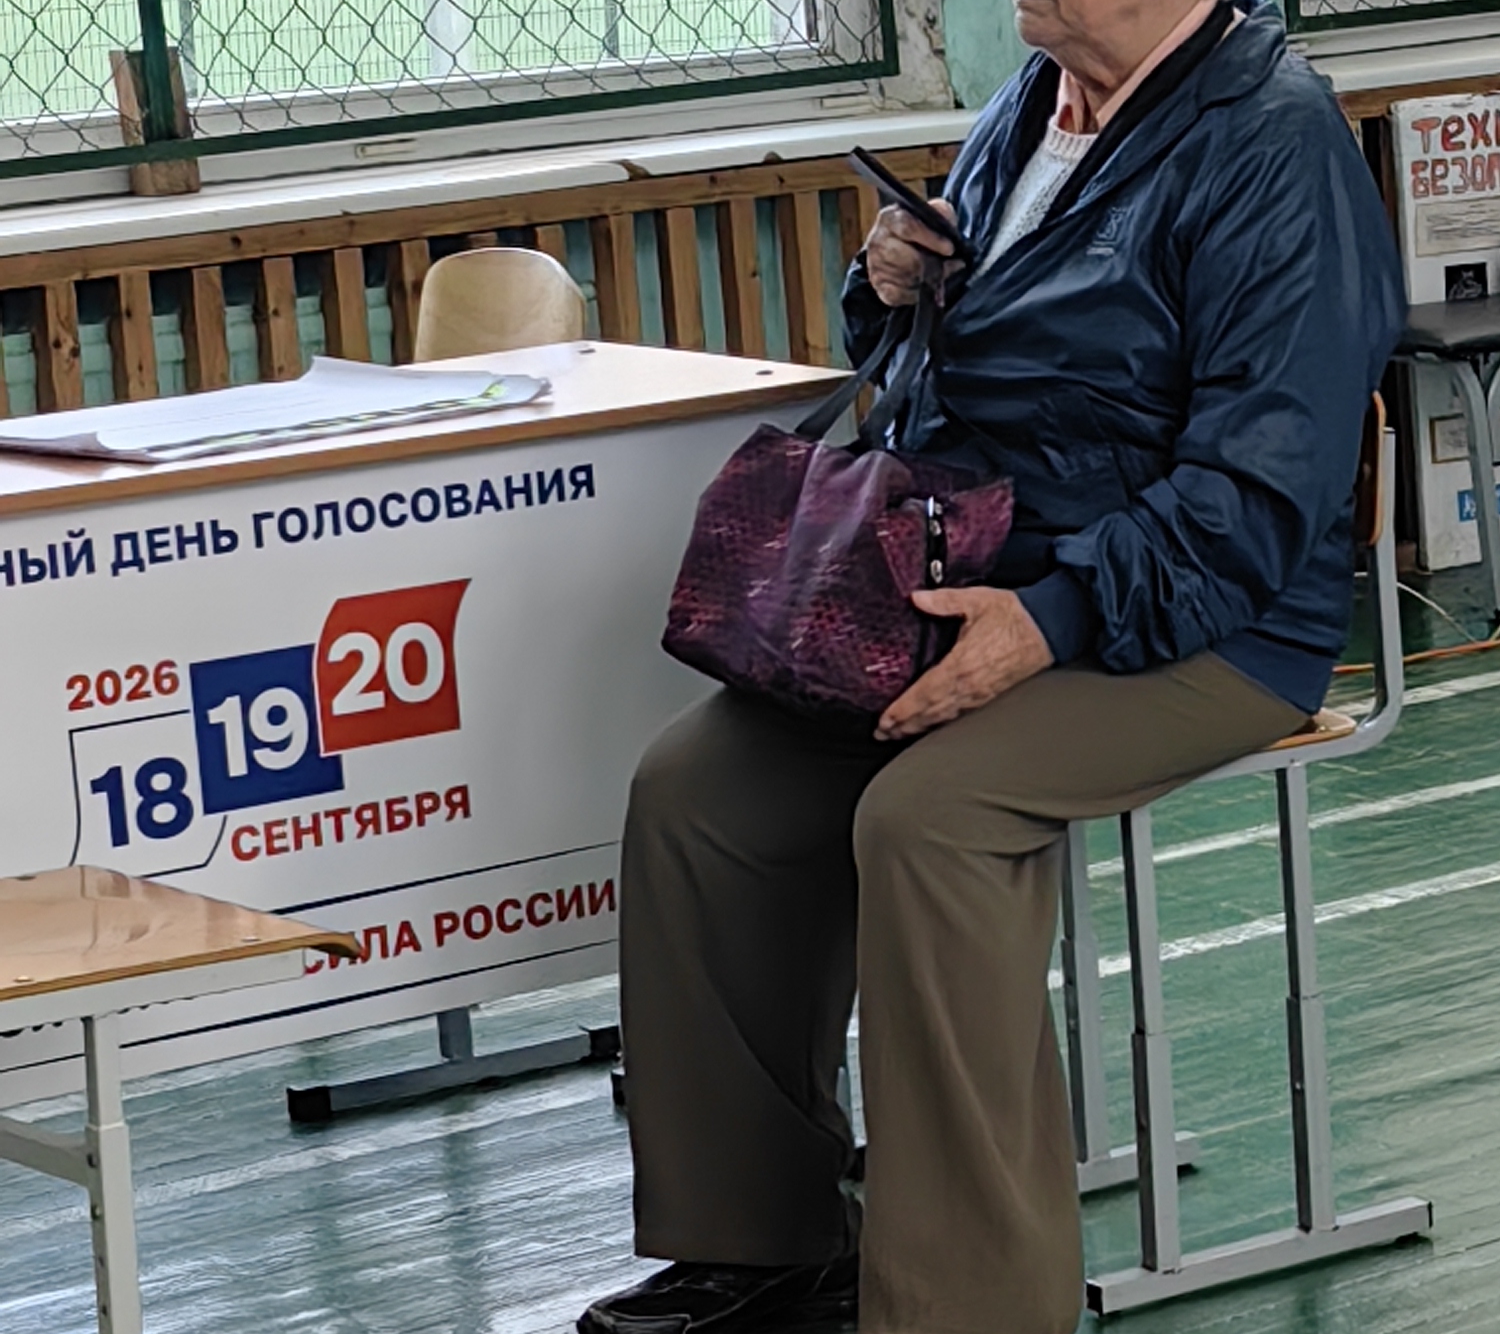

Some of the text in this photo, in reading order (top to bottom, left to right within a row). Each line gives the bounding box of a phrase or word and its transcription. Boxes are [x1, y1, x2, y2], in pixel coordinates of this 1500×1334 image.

[110, 519, 239, 577] ДЕНЬ
[252, 464, 596, 549] ГОЛОСОВАНИЯ
[66, 660, 180, 711] 2026
[90, 622, 445, 847] 18 19 20
[230, 784, 471, 863] СЕНТЯБРЯ
[433, 878, 617, 948] РОССИИ
